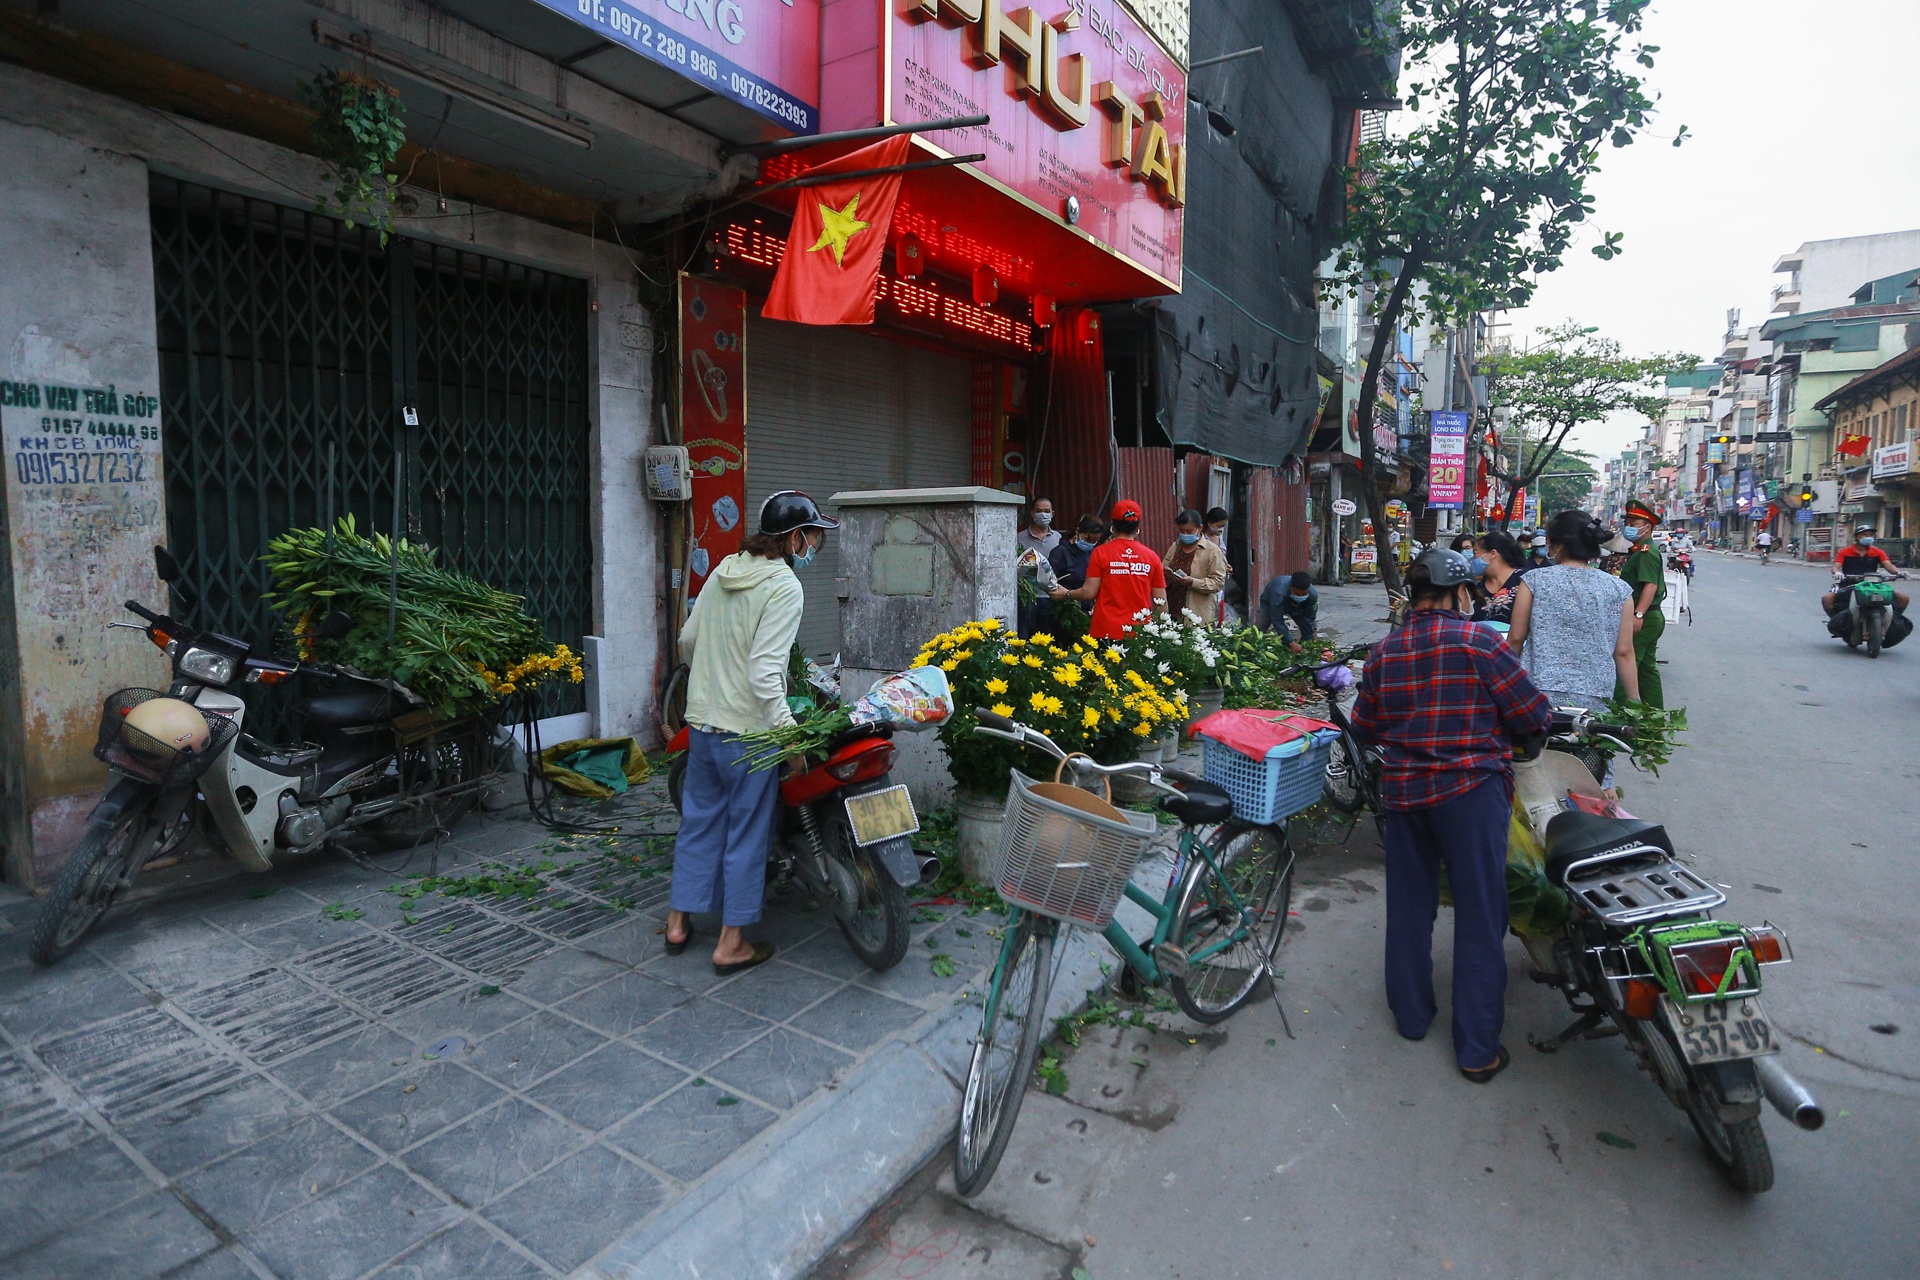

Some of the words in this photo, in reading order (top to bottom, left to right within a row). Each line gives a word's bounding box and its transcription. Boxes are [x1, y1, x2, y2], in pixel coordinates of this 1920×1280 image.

[610, 6, 652, 48] 0972
[657, 32, 686, 65] 289
[690, 50, 718, 81] 986
[731, 72, 808, 129] 0978223393
[1088, 4, 1124, 55] BẠC
[1127, 42, 1149, 81] ĐÁ
[1151, 67, 1179, 107] QUÝ
[932, 76, 951, 98] KINH
[953, 89, 979, 116] DOANH
[1108, 79, 1187, 208] TÀI
[0, 380, 41, 409] CHO
[44, 385, 78, 412] VAY
[83, 384, 119, 416] TRẢ
[124, 391, 159, 418] GÓP
[15, 452, 146, 485] 0915327232
[1430, 457, 1447, 466] GIẢM
[1447, 457, 1464, 466] THÊM
[1130, 562, 1151, 573] 2019
